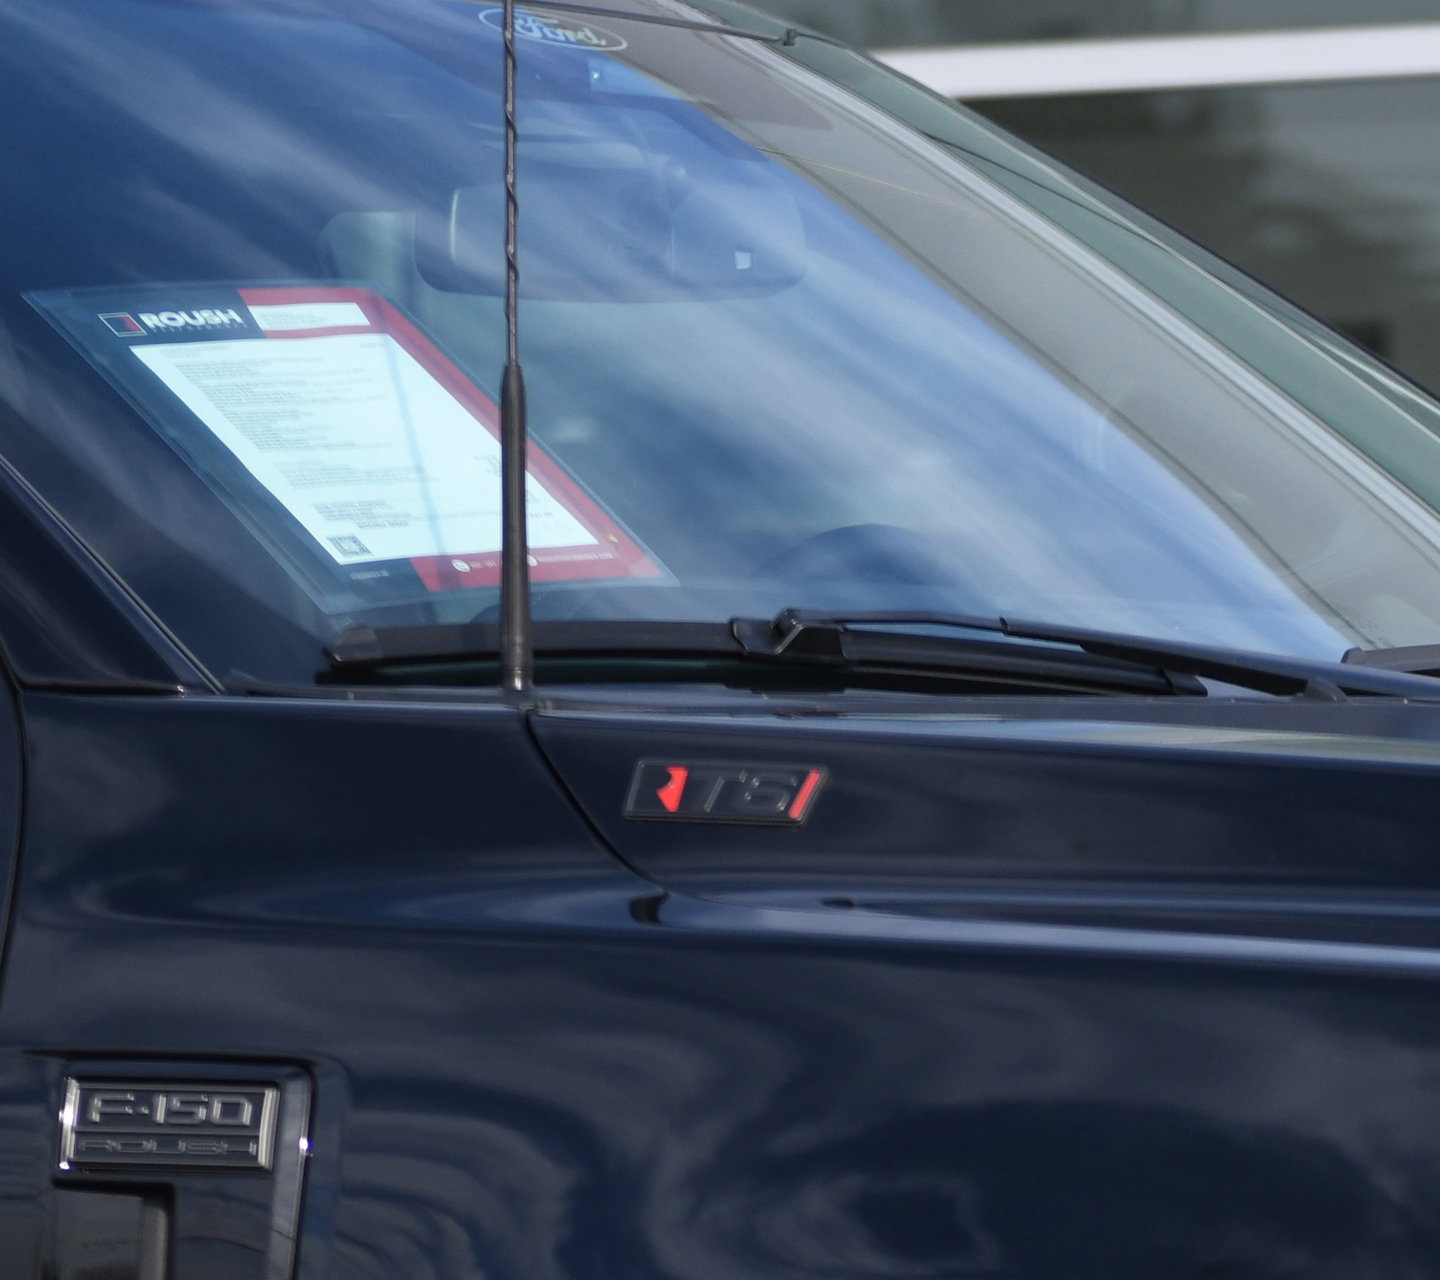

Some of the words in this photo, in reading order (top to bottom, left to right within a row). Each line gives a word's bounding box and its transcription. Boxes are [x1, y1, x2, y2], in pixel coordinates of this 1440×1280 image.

[137, 308, 243, 329] ROUSH
[87, 1092, 253, 1127] F-150
[78, 1138, 258, 1156] ROUSH
